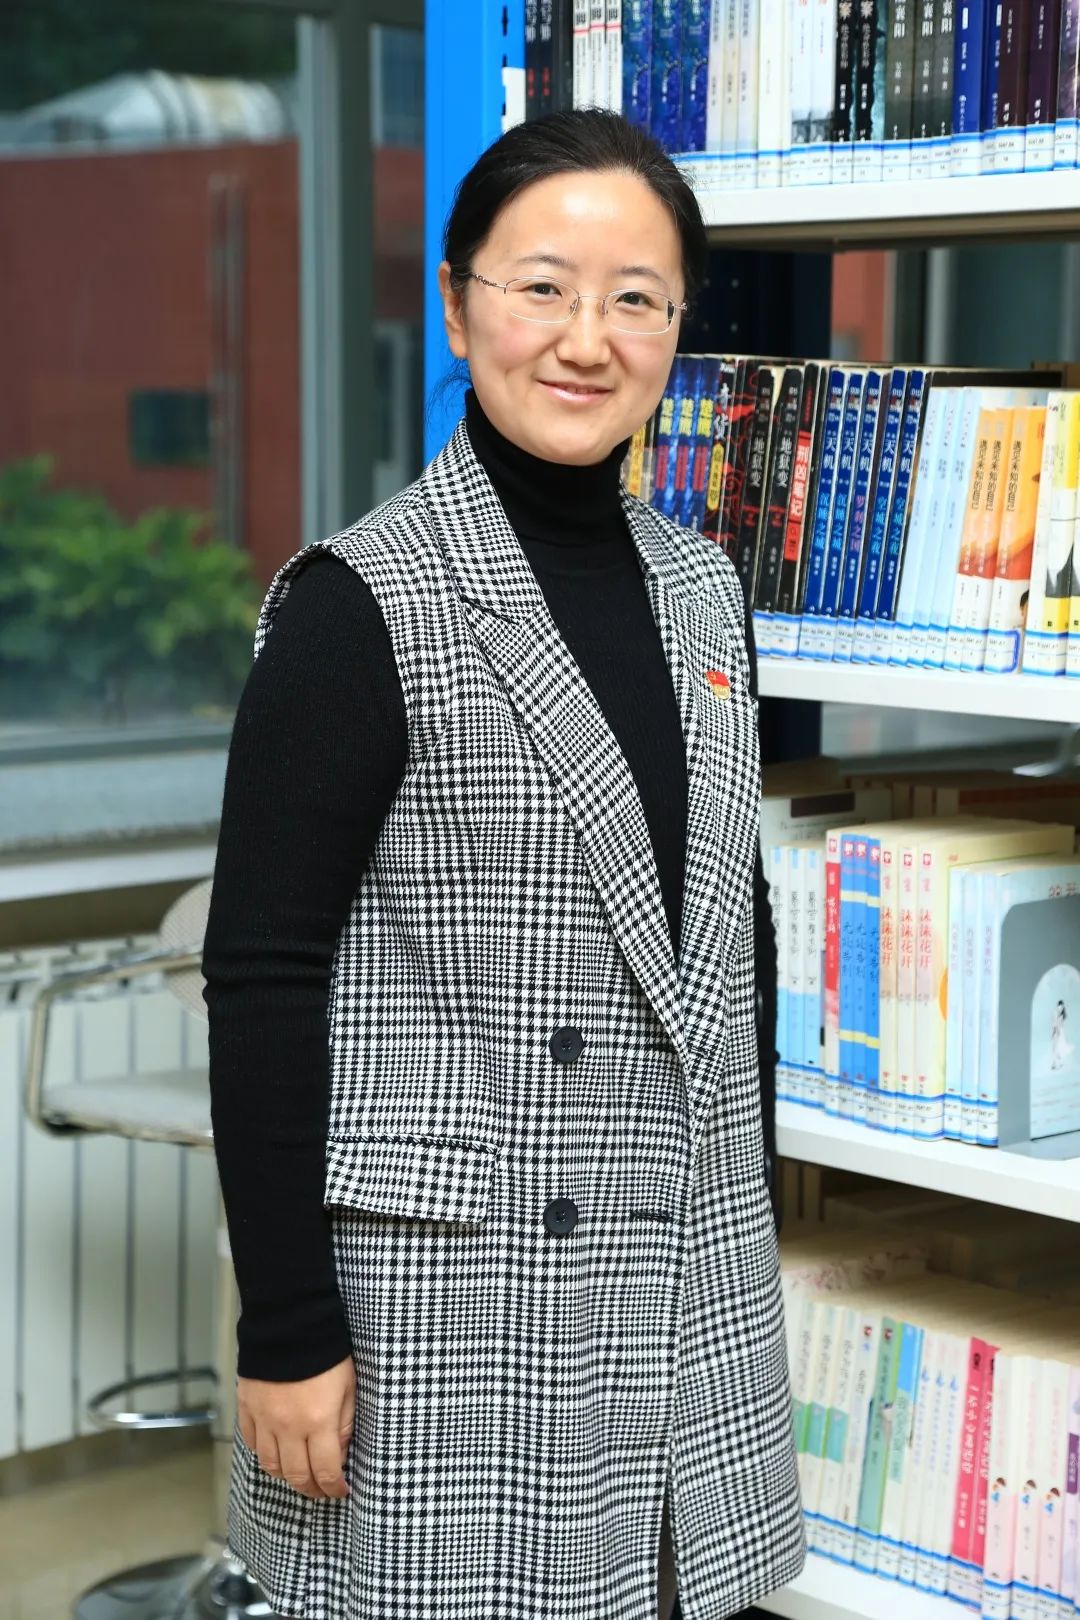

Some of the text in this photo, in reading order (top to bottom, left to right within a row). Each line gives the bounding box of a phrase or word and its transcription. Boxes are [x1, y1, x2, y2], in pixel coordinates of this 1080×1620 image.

[823, 437, 837, 470] 天机
[841, 437, 855, 470] 天机
[860, 438, 873, 472] 天机
[881, 438, 896, 473] 天机
[900, 439, 915, 473] 天机
